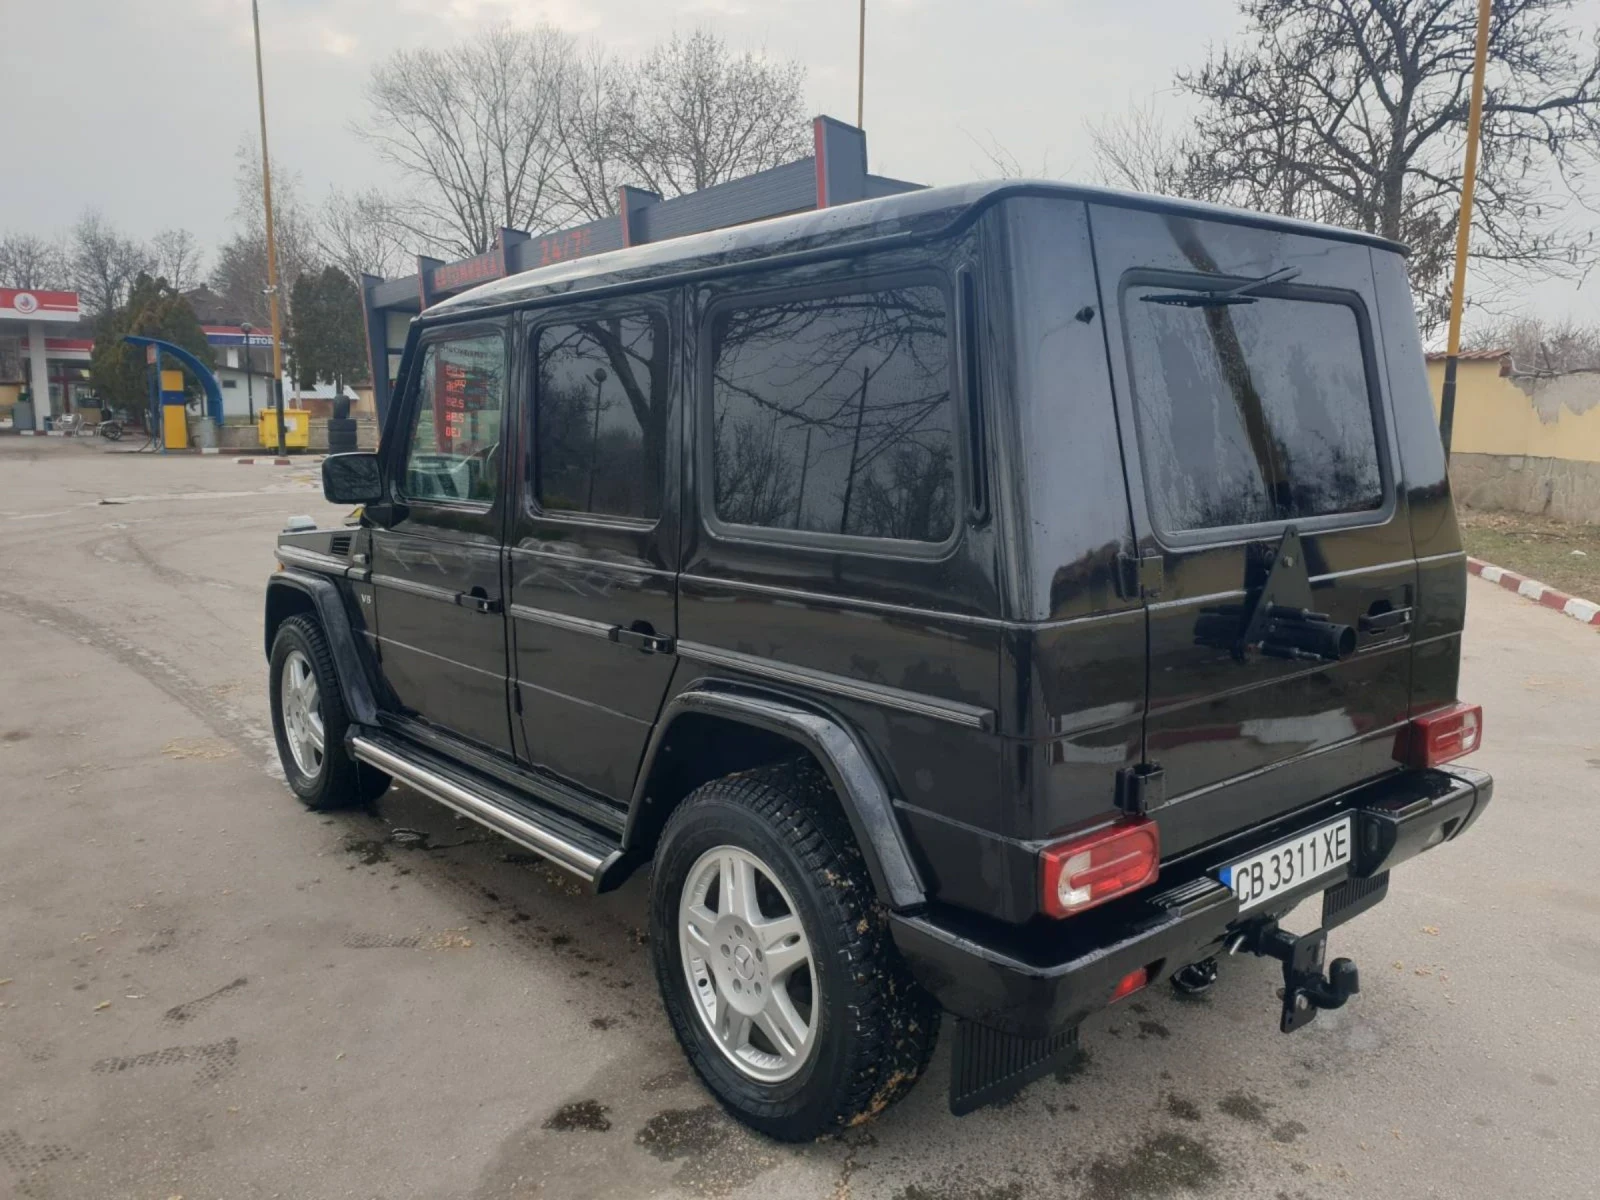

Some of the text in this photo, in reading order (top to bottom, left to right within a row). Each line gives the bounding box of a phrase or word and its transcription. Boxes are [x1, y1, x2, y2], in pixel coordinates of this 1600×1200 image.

[1236, 824, 1347, 904] CB 3311 XE
